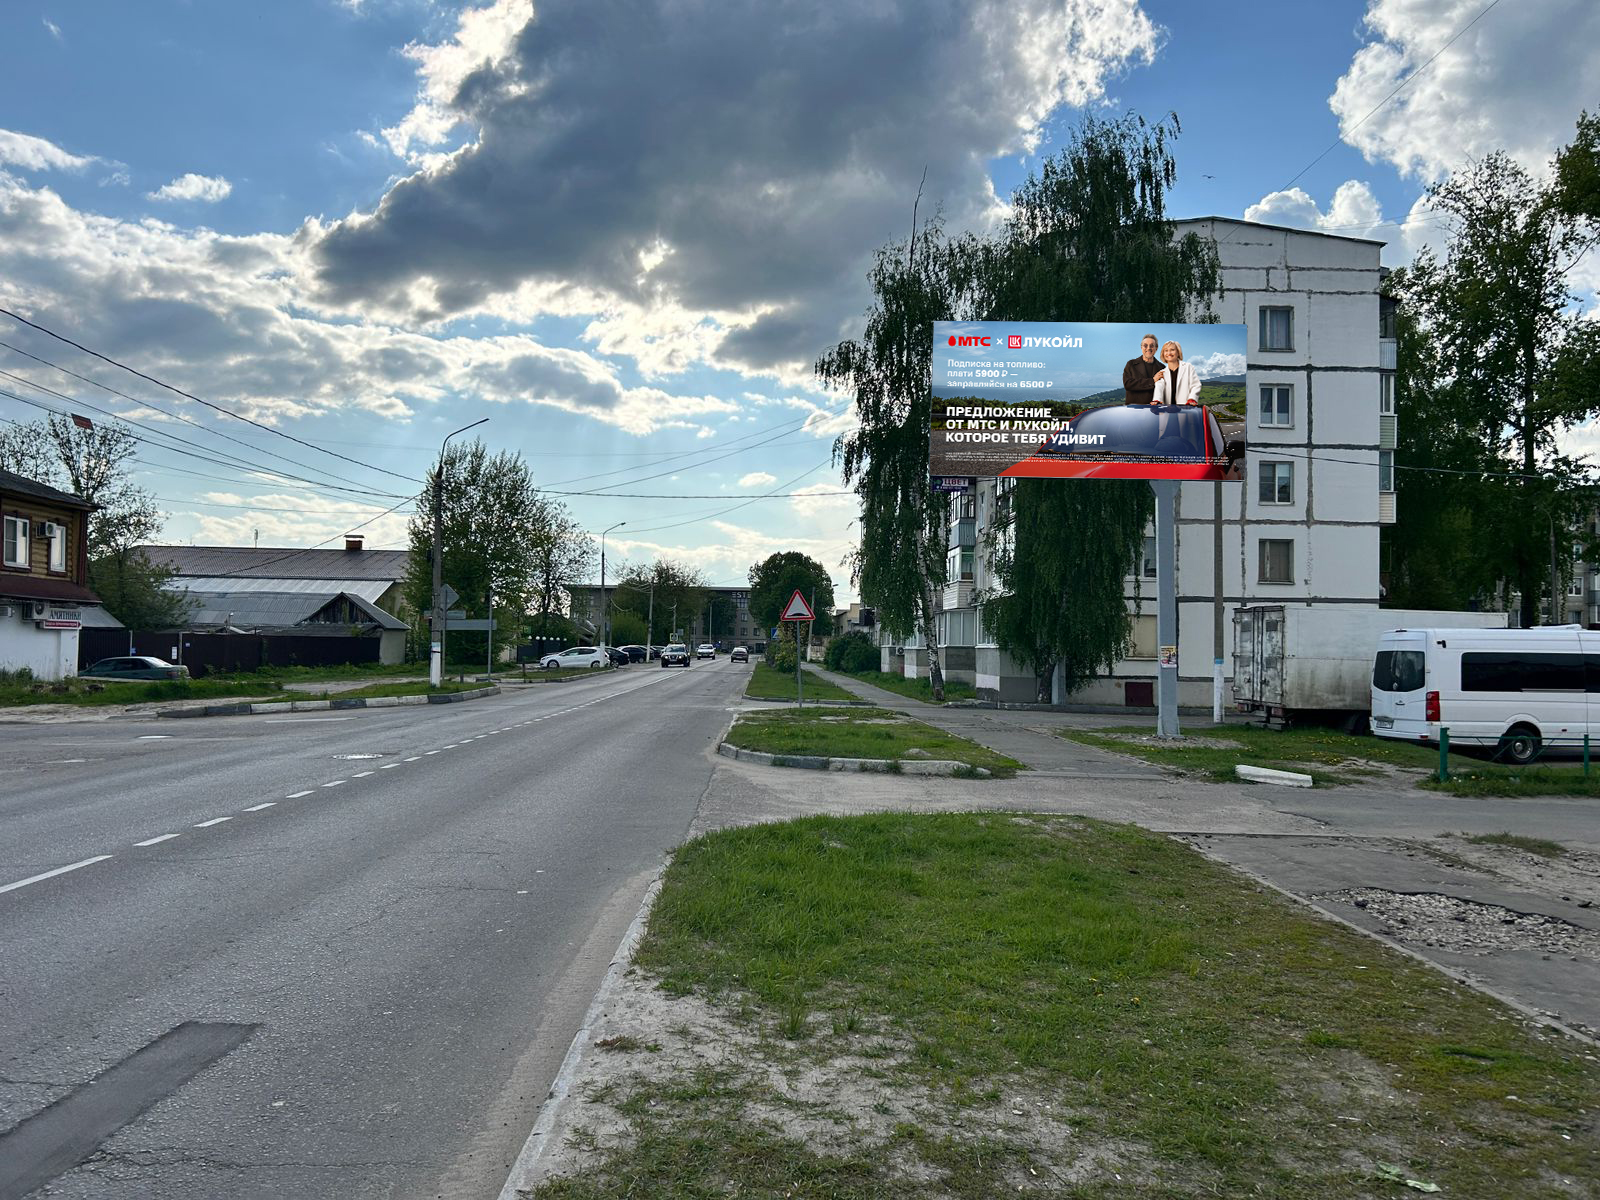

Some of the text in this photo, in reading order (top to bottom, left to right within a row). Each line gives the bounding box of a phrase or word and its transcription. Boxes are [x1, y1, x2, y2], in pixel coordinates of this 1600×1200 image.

[958, 336, 991, 347] МТС
[1023, 335, 1083, 348] ЛУКОЙЛ
[947, 359, 992, 369] Подписка
[1006, 361, 1046, 369] топливо:
[947, 370, 973, 378] плати
[975, 369, 1000, 378] 5900
[947, 379, 1005, 389] заправляйся
[946, 406, 1052, 419] ПРЕДЛОЖЕНИЕ
[945, 418, 1074, 433] ОТ МТС И ЛУКОЙЛ,
[945, 432, 1106, 446] КОТОРОЕ ТЕБЯ УДИВИТ
[49, 610, 82, 620] АМЯТНИКИ
